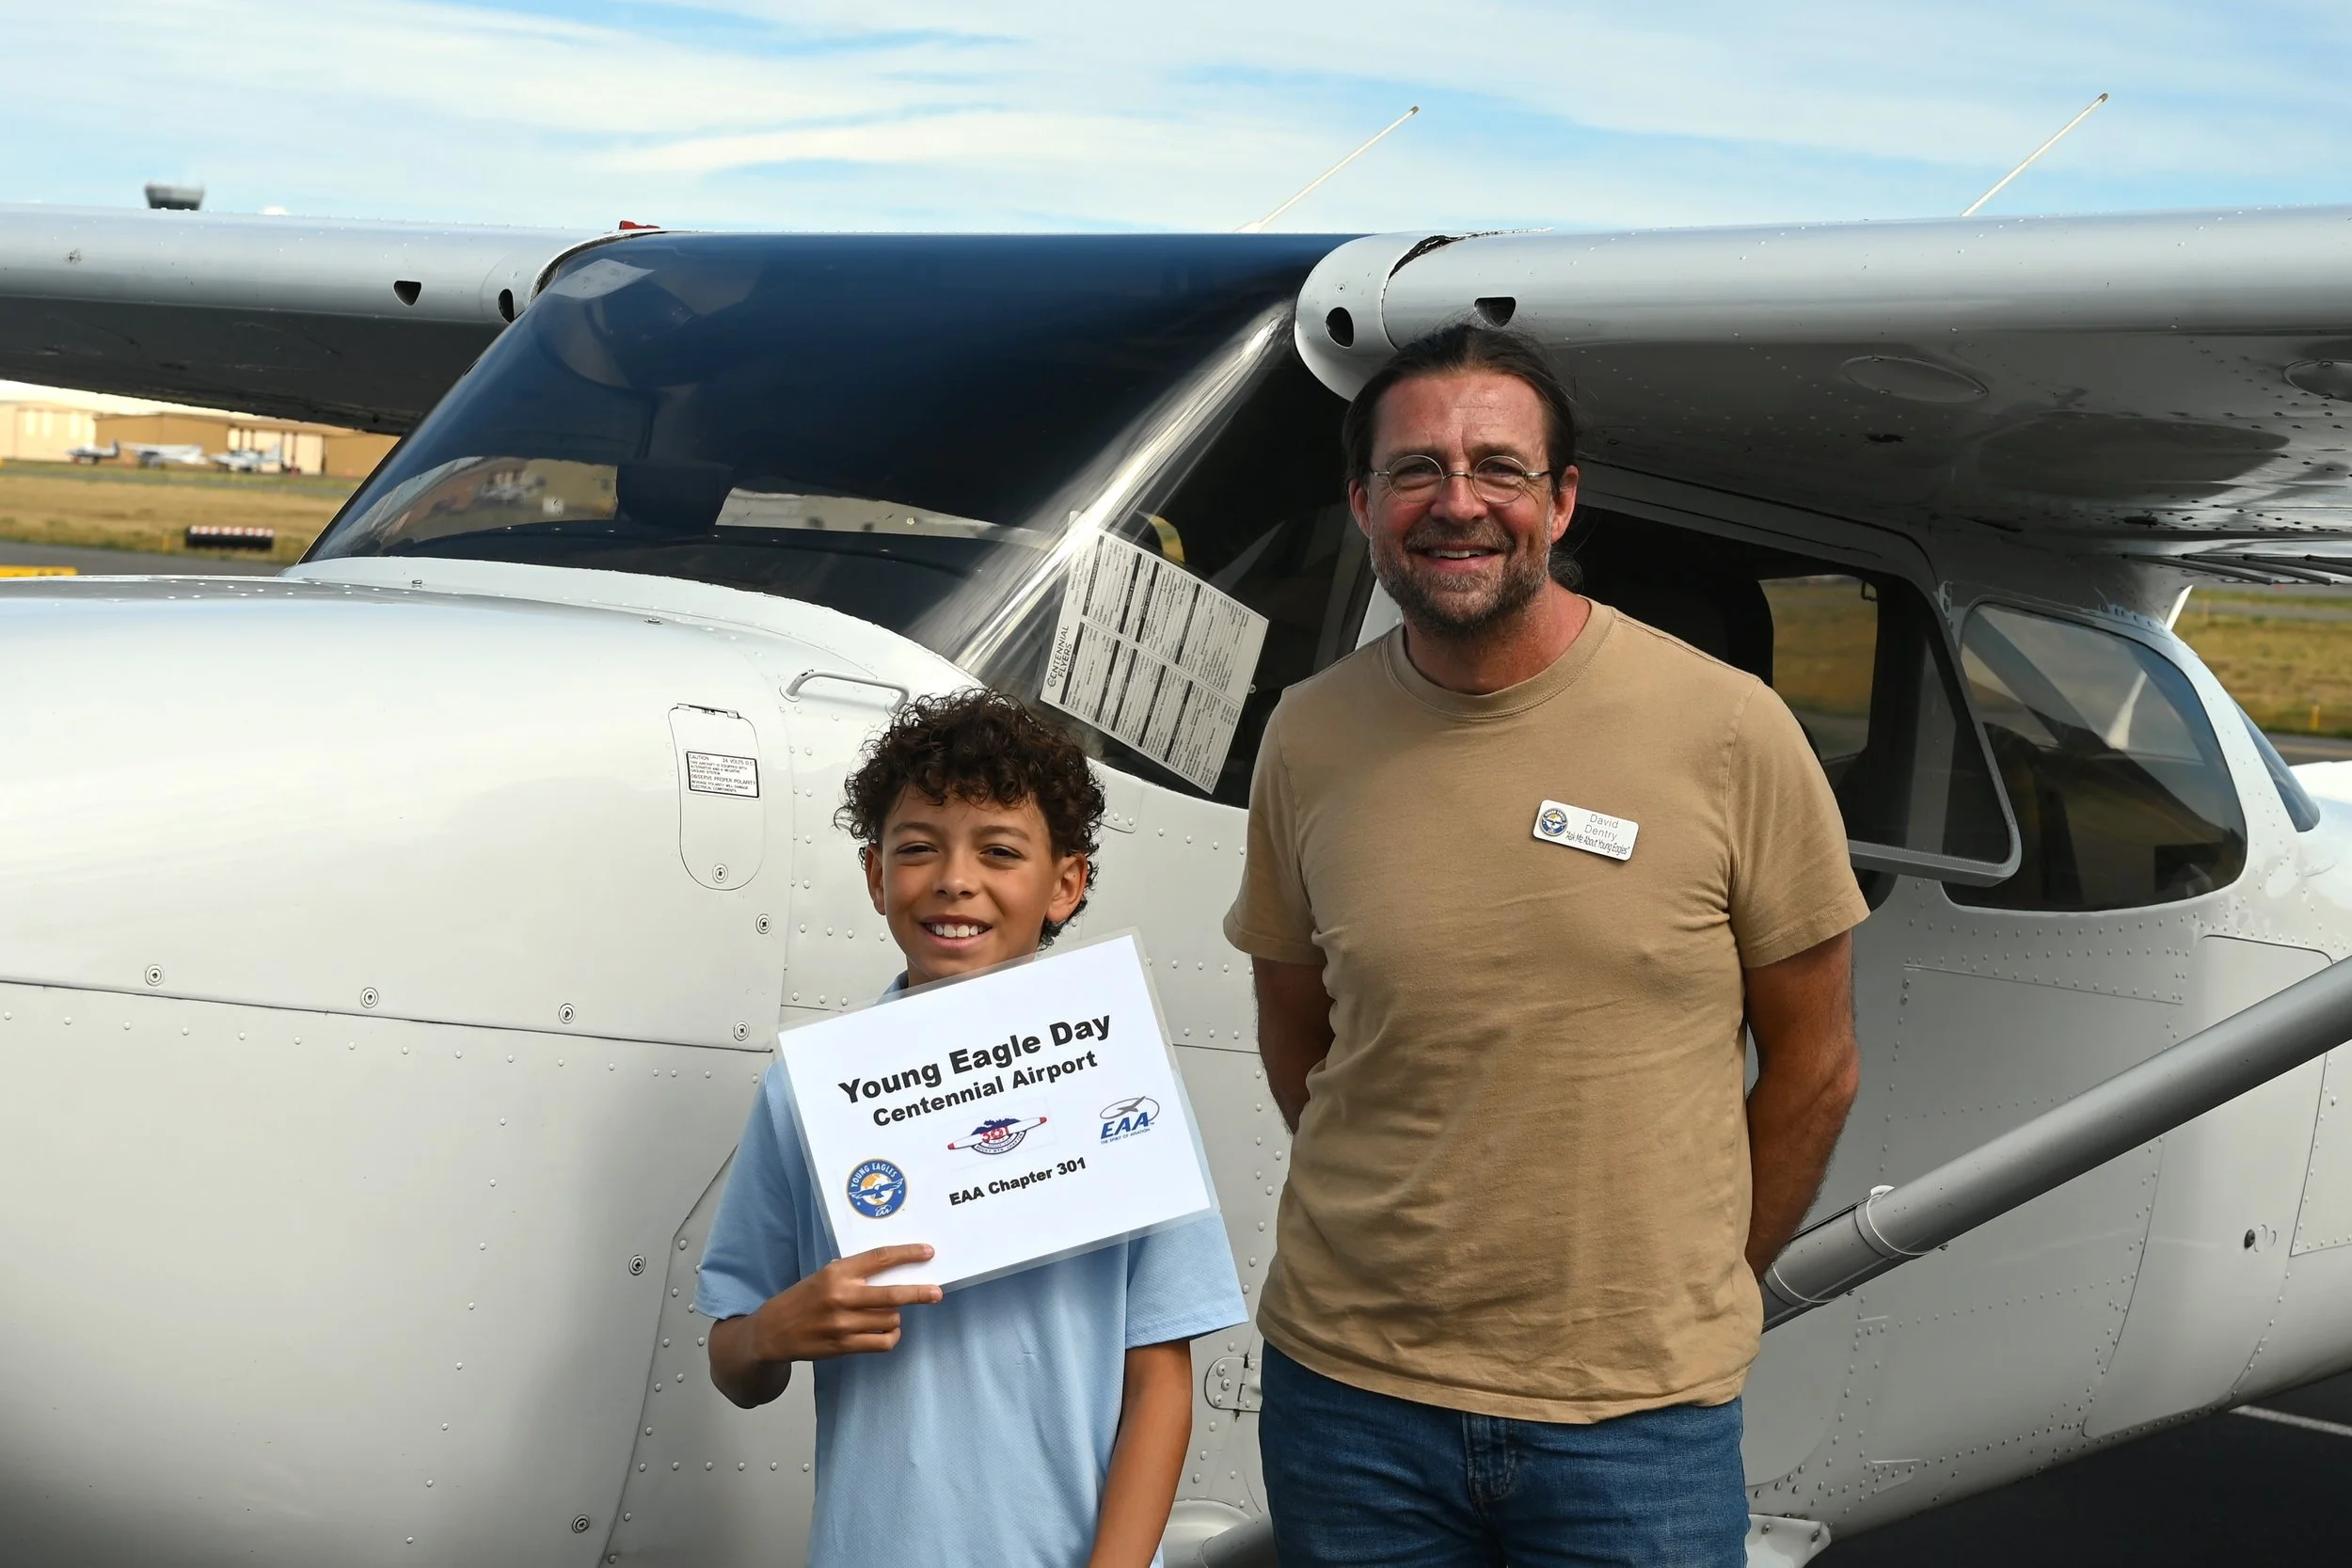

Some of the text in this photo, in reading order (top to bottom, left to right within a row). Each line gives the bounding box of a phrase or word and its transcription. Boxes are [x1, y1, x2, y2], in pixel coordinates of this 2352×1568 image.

[1048, 626, 1069, 687] CENTENNIAL
[1058, 643, 1073, 677] FLYERS
[1584, 824, 1618, 842] Dentry
[1590, 814, 1618, 829] David
[838, 1015, 1111, 1104] Young Eagle Day
[873, 1050, 1098, 1127] Centennial Airport
[982, 1126, 1009, 1144] 301
[1100, 1112, 1149, 1140] EAA
[851, 1163, 898, 1188] YOUNG EAGLES
[948, 1156, 1087, 1206] EAA Chapter 301
